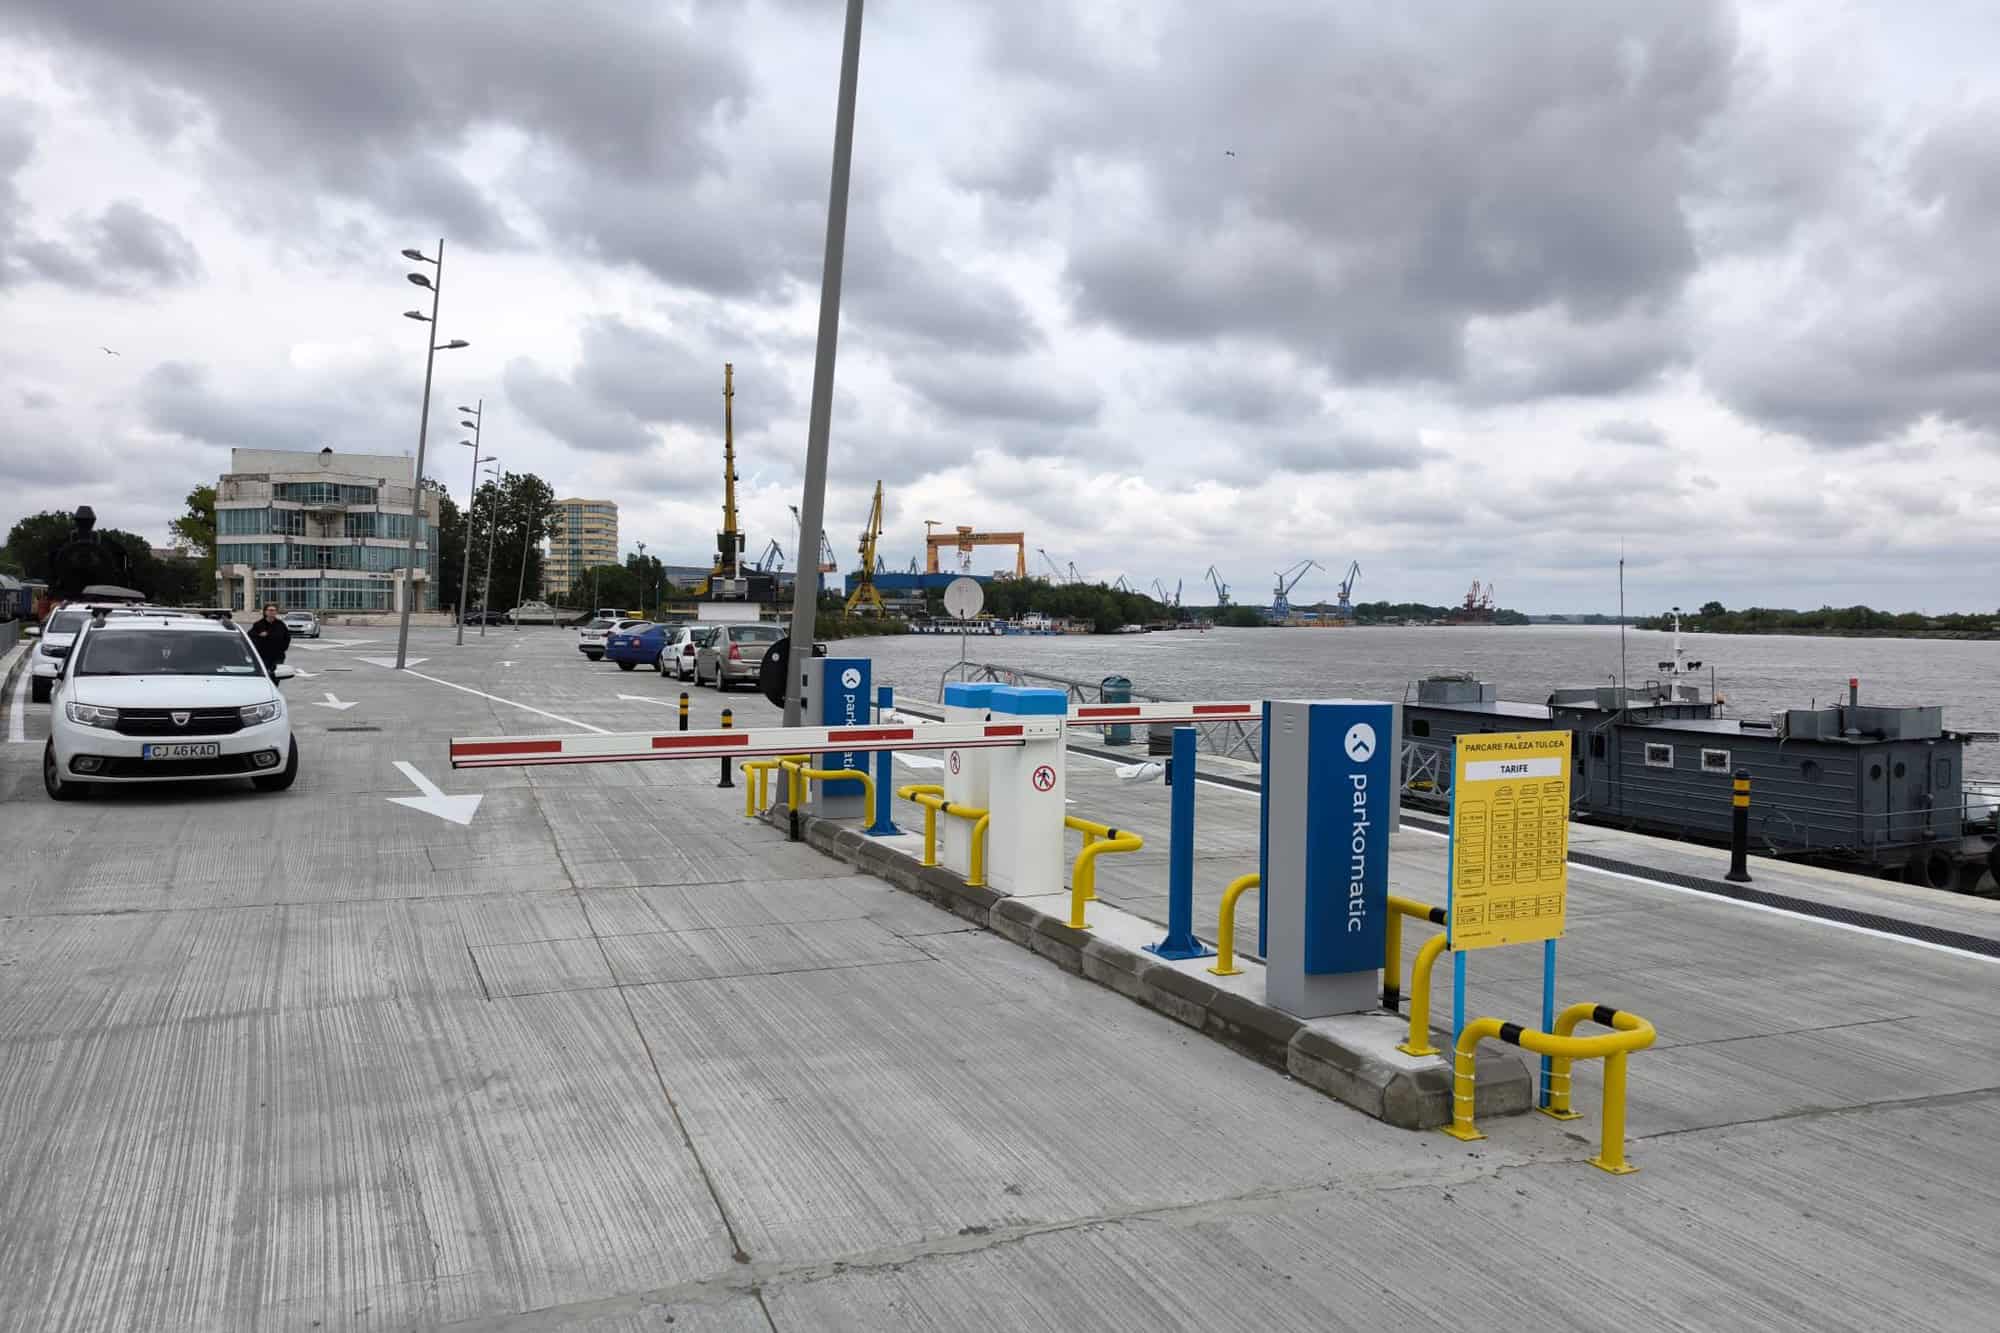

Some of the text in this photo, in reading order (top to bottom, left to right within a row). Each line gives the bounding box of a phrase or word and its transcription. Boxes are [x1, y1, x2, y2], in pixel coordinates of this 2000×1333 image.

[843, 694, 857, 771] parkati
[152, 746, 169, 757] CJ
[1465, 740, 1565, 752] PARCARE FALEZA TULCEA
[1500, 764, 1529, 773] TARIFE
[1347, 774, 1371, 932] parkomatic
